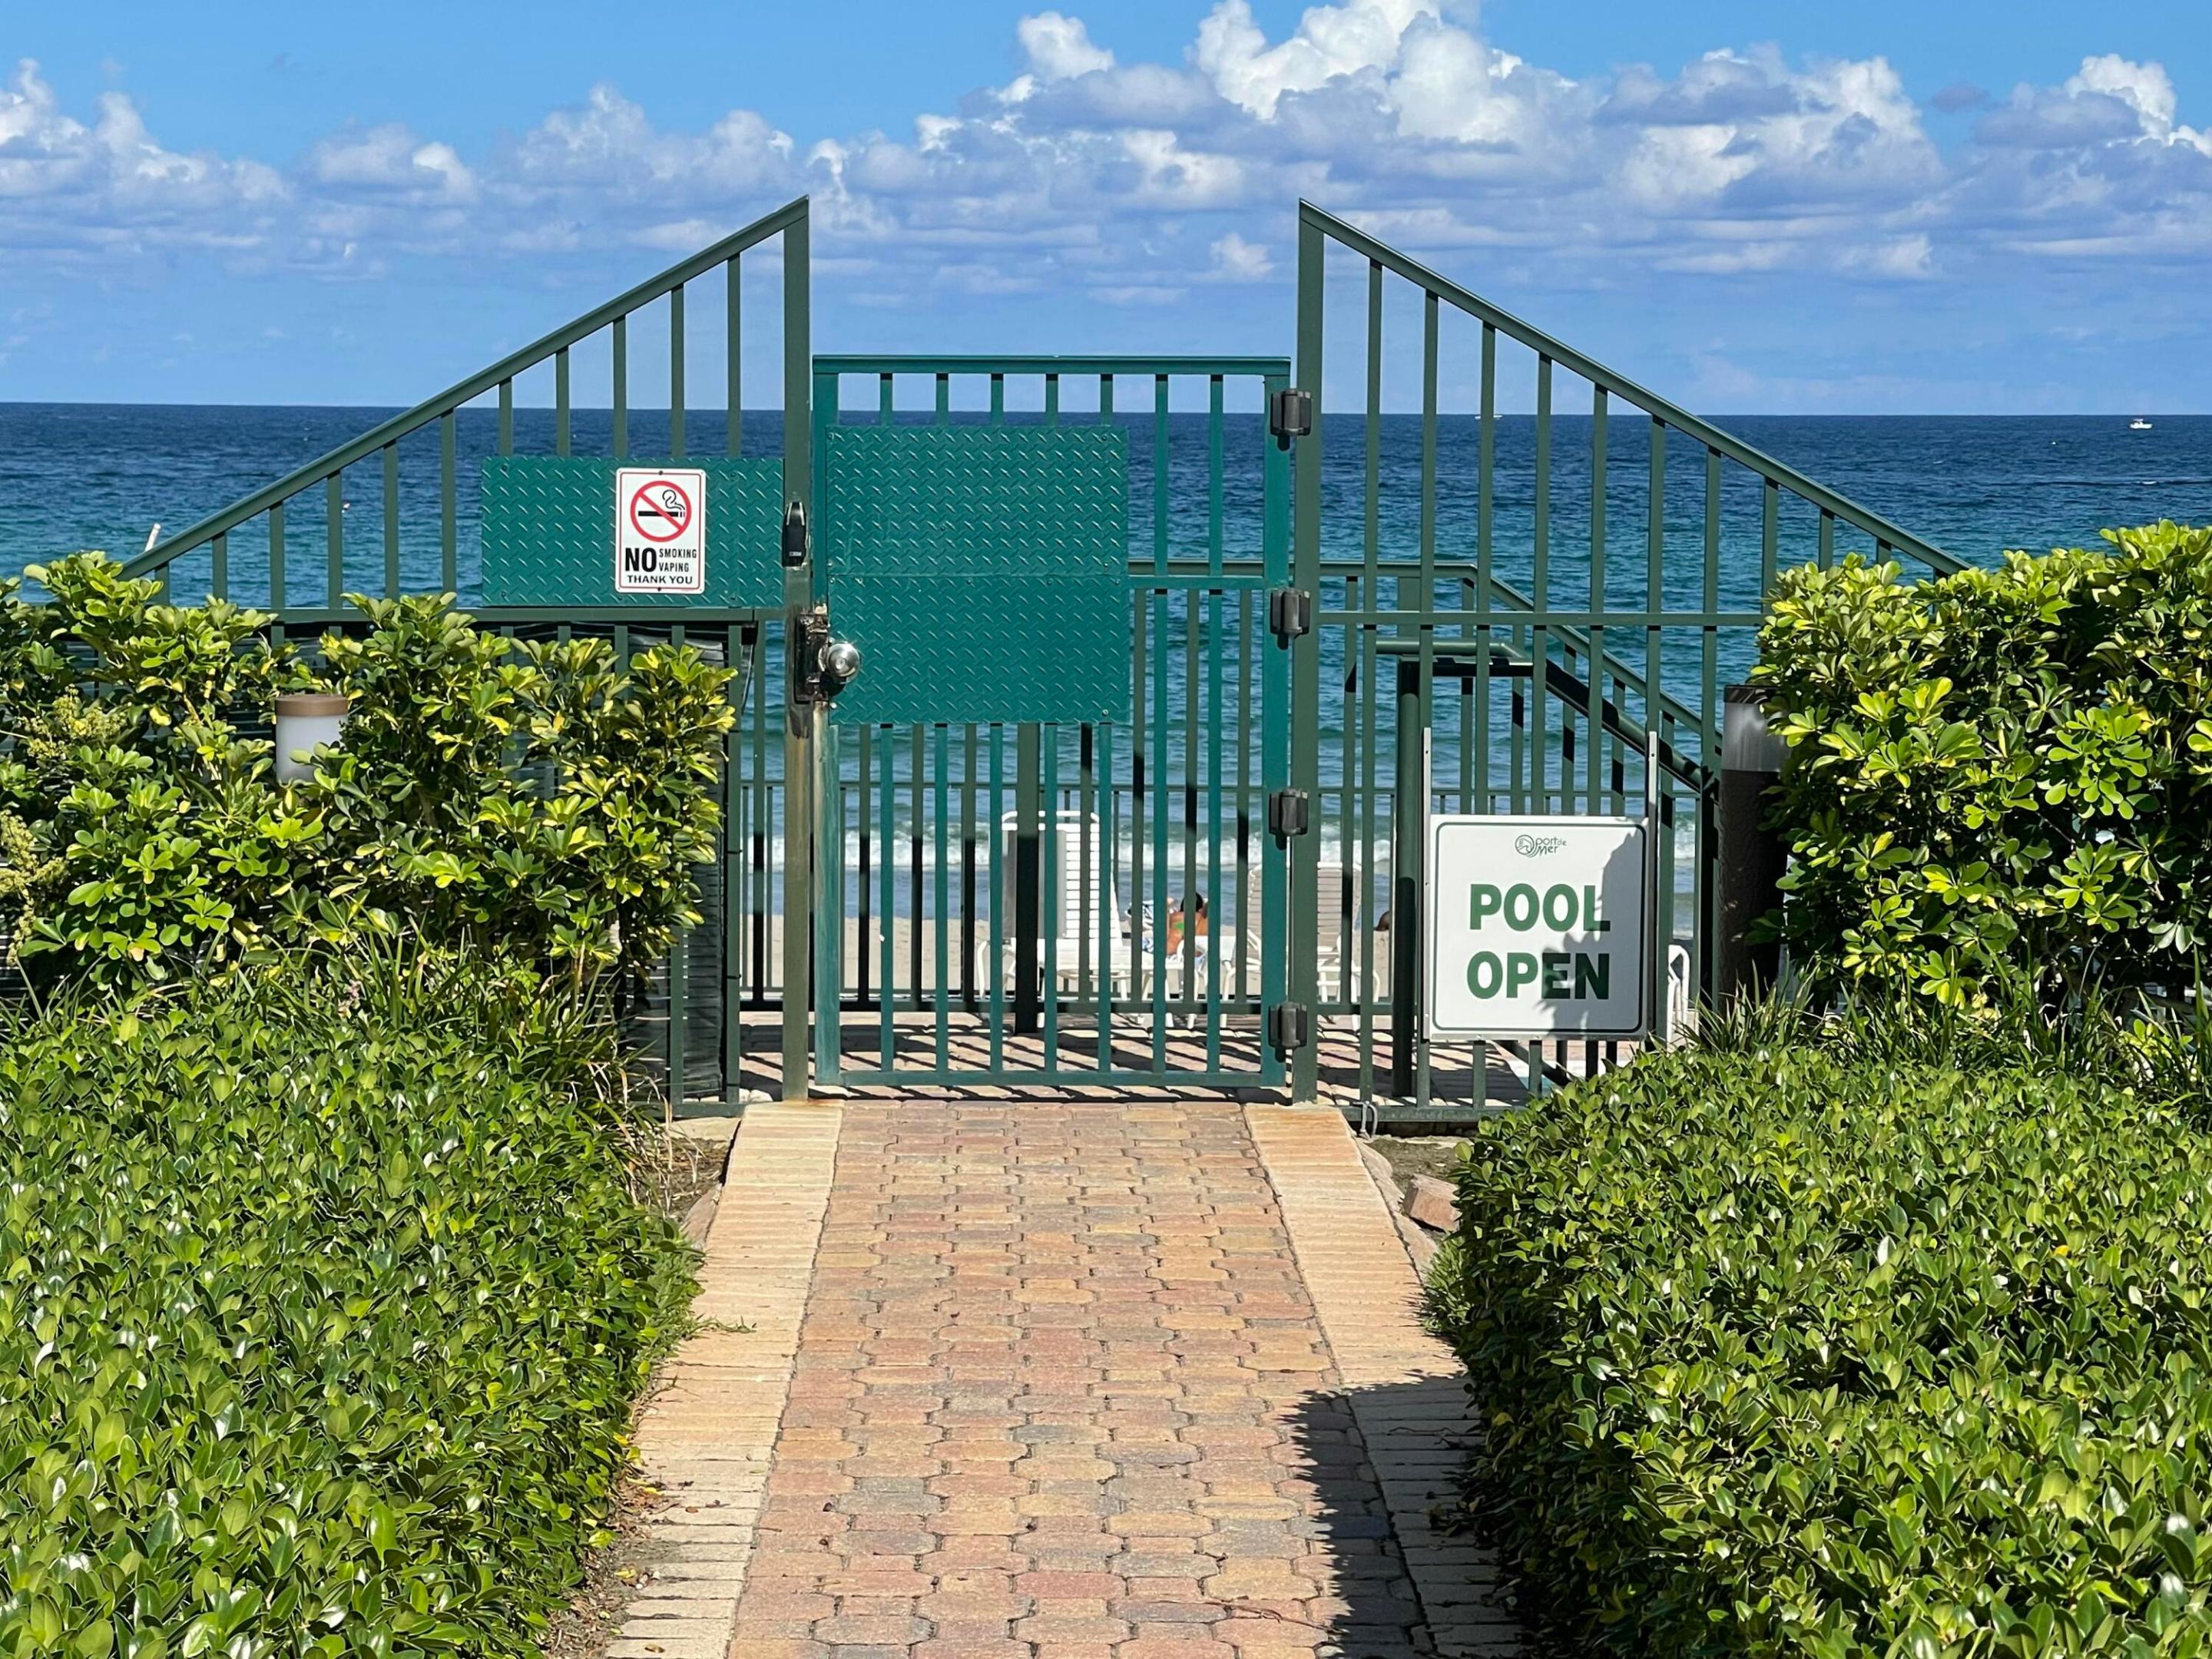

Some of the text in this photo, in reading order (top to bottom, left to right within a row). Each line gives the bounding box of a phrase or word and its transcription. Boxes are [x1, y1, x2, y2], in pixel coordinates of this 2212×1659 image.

[624, 547, 697, 572] NO SMOKING
[659, 562, 690, 572] VAPING
[627, 575, 693, 584] THANK YOU
[1469, 883, 1611, 932] POOL
[1467, 951, 1610, 999] OPEN
